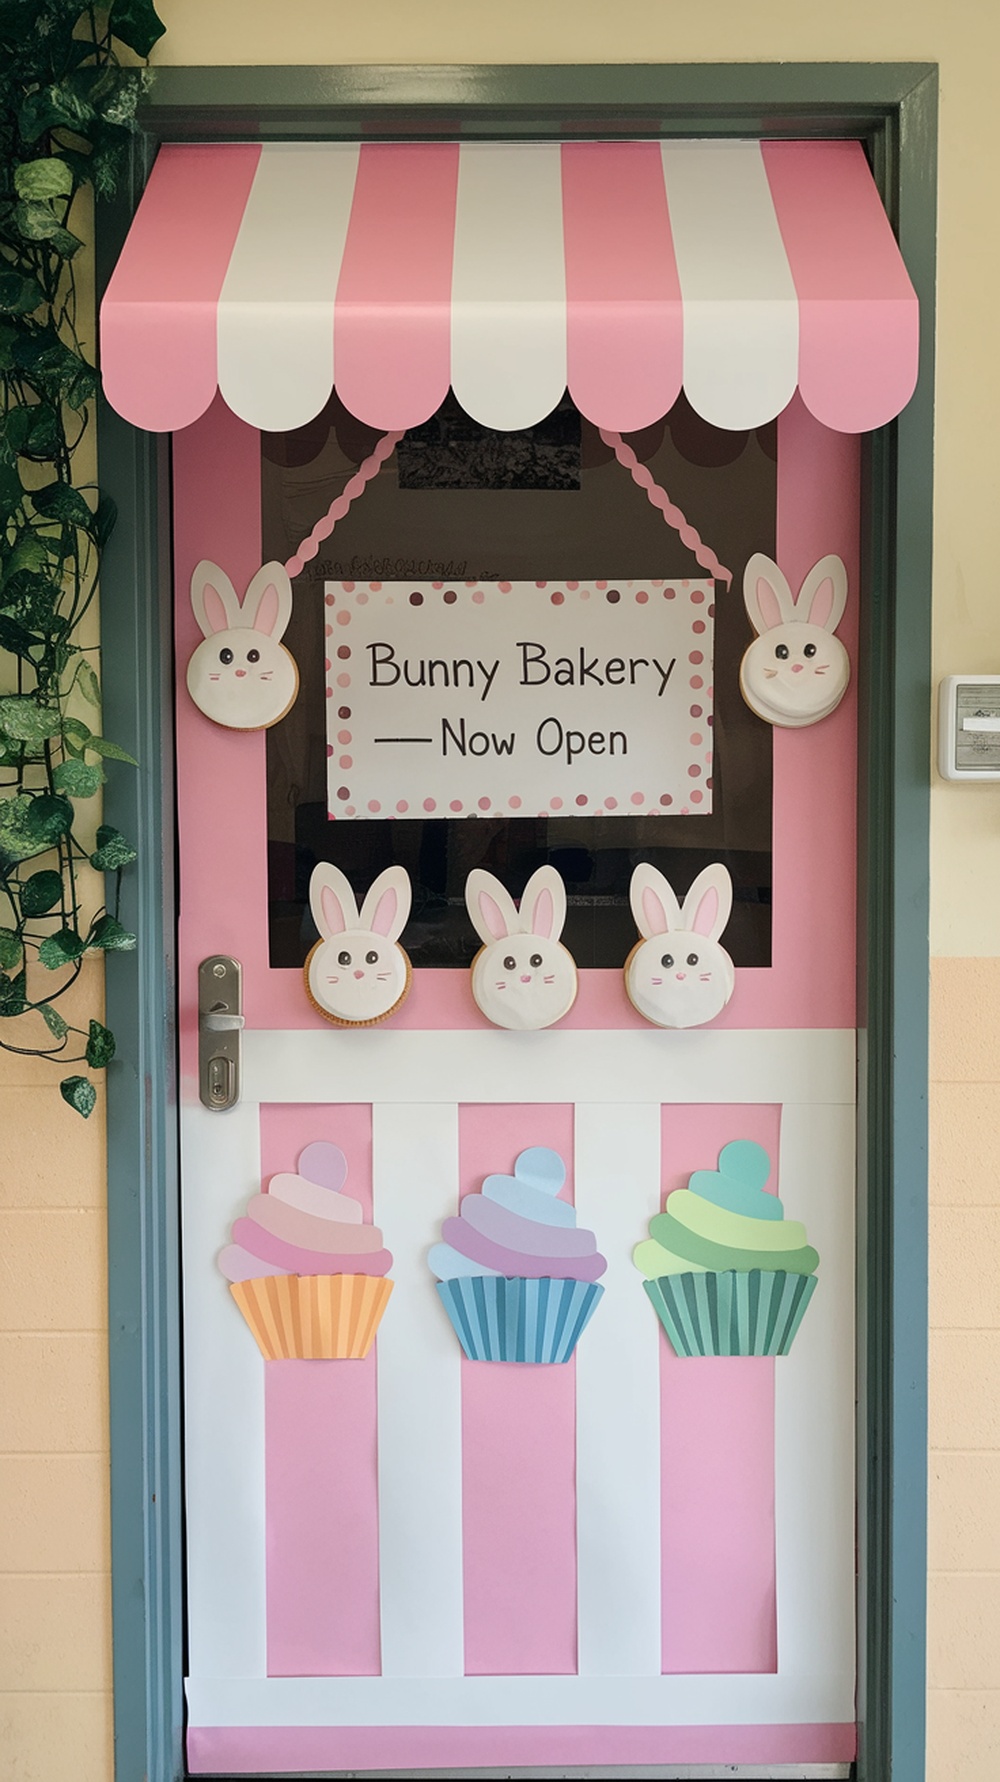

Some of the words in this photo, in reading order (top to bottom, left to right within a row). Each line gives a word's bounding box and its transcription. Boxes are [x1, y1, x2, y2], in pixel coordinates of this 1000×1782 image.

[366, 642, 500, 701] Bunny
[516, 642, 676, 697] Bakery
[537, 716, 628, 765] Open
